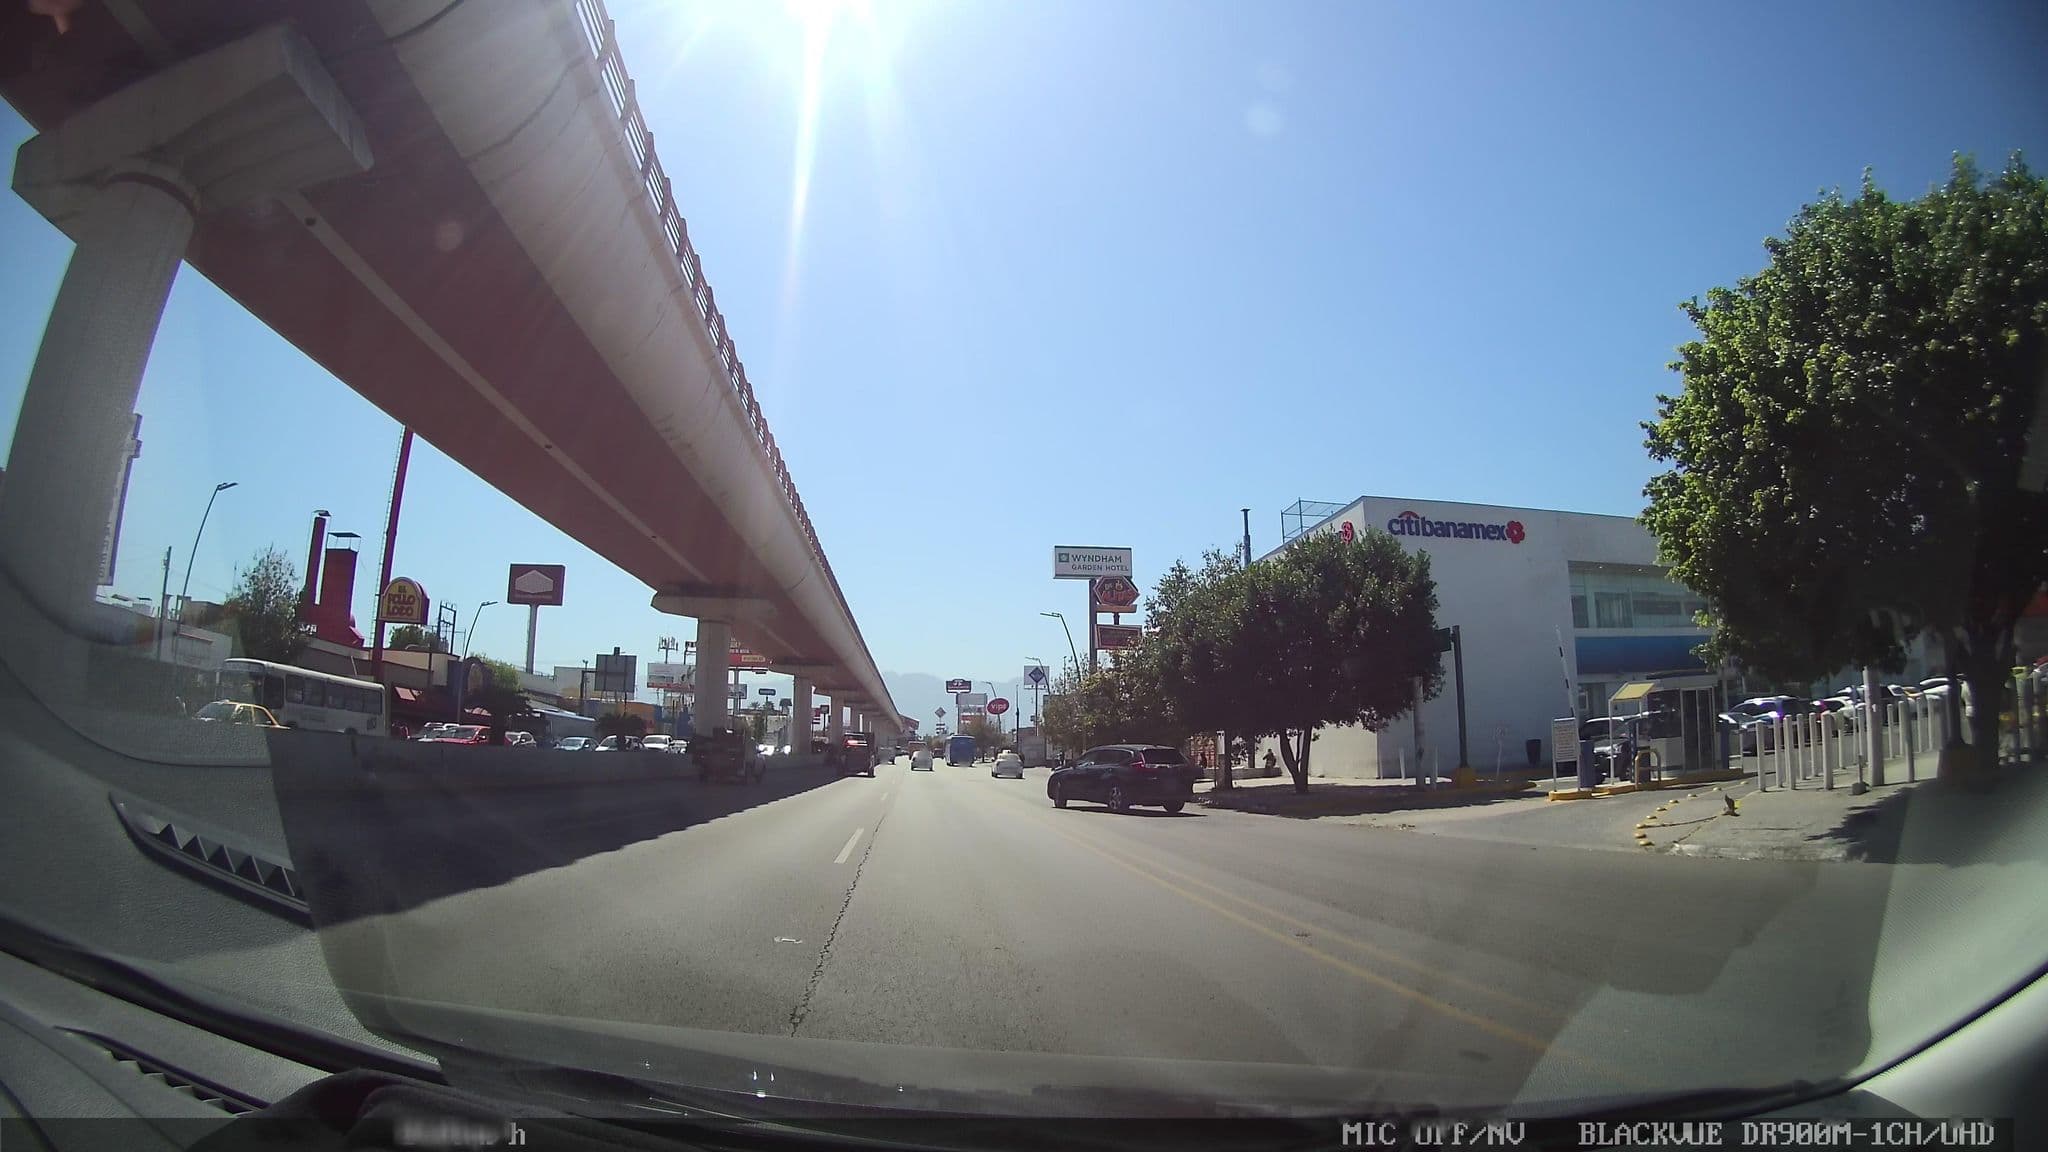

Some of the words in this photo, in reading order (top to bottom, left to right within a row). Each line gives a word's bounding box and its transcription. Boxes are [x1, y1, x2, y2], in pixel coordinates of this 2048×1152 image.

[1387, 512, 1507, 541] citibanamex
[1071, 554, 1122, 563] WYNDHAM
[1105, 564, 1129, 572] HOTEL
[387, 592, 416, 605] POLLO
[386, 605, 414, 617] LOCO
